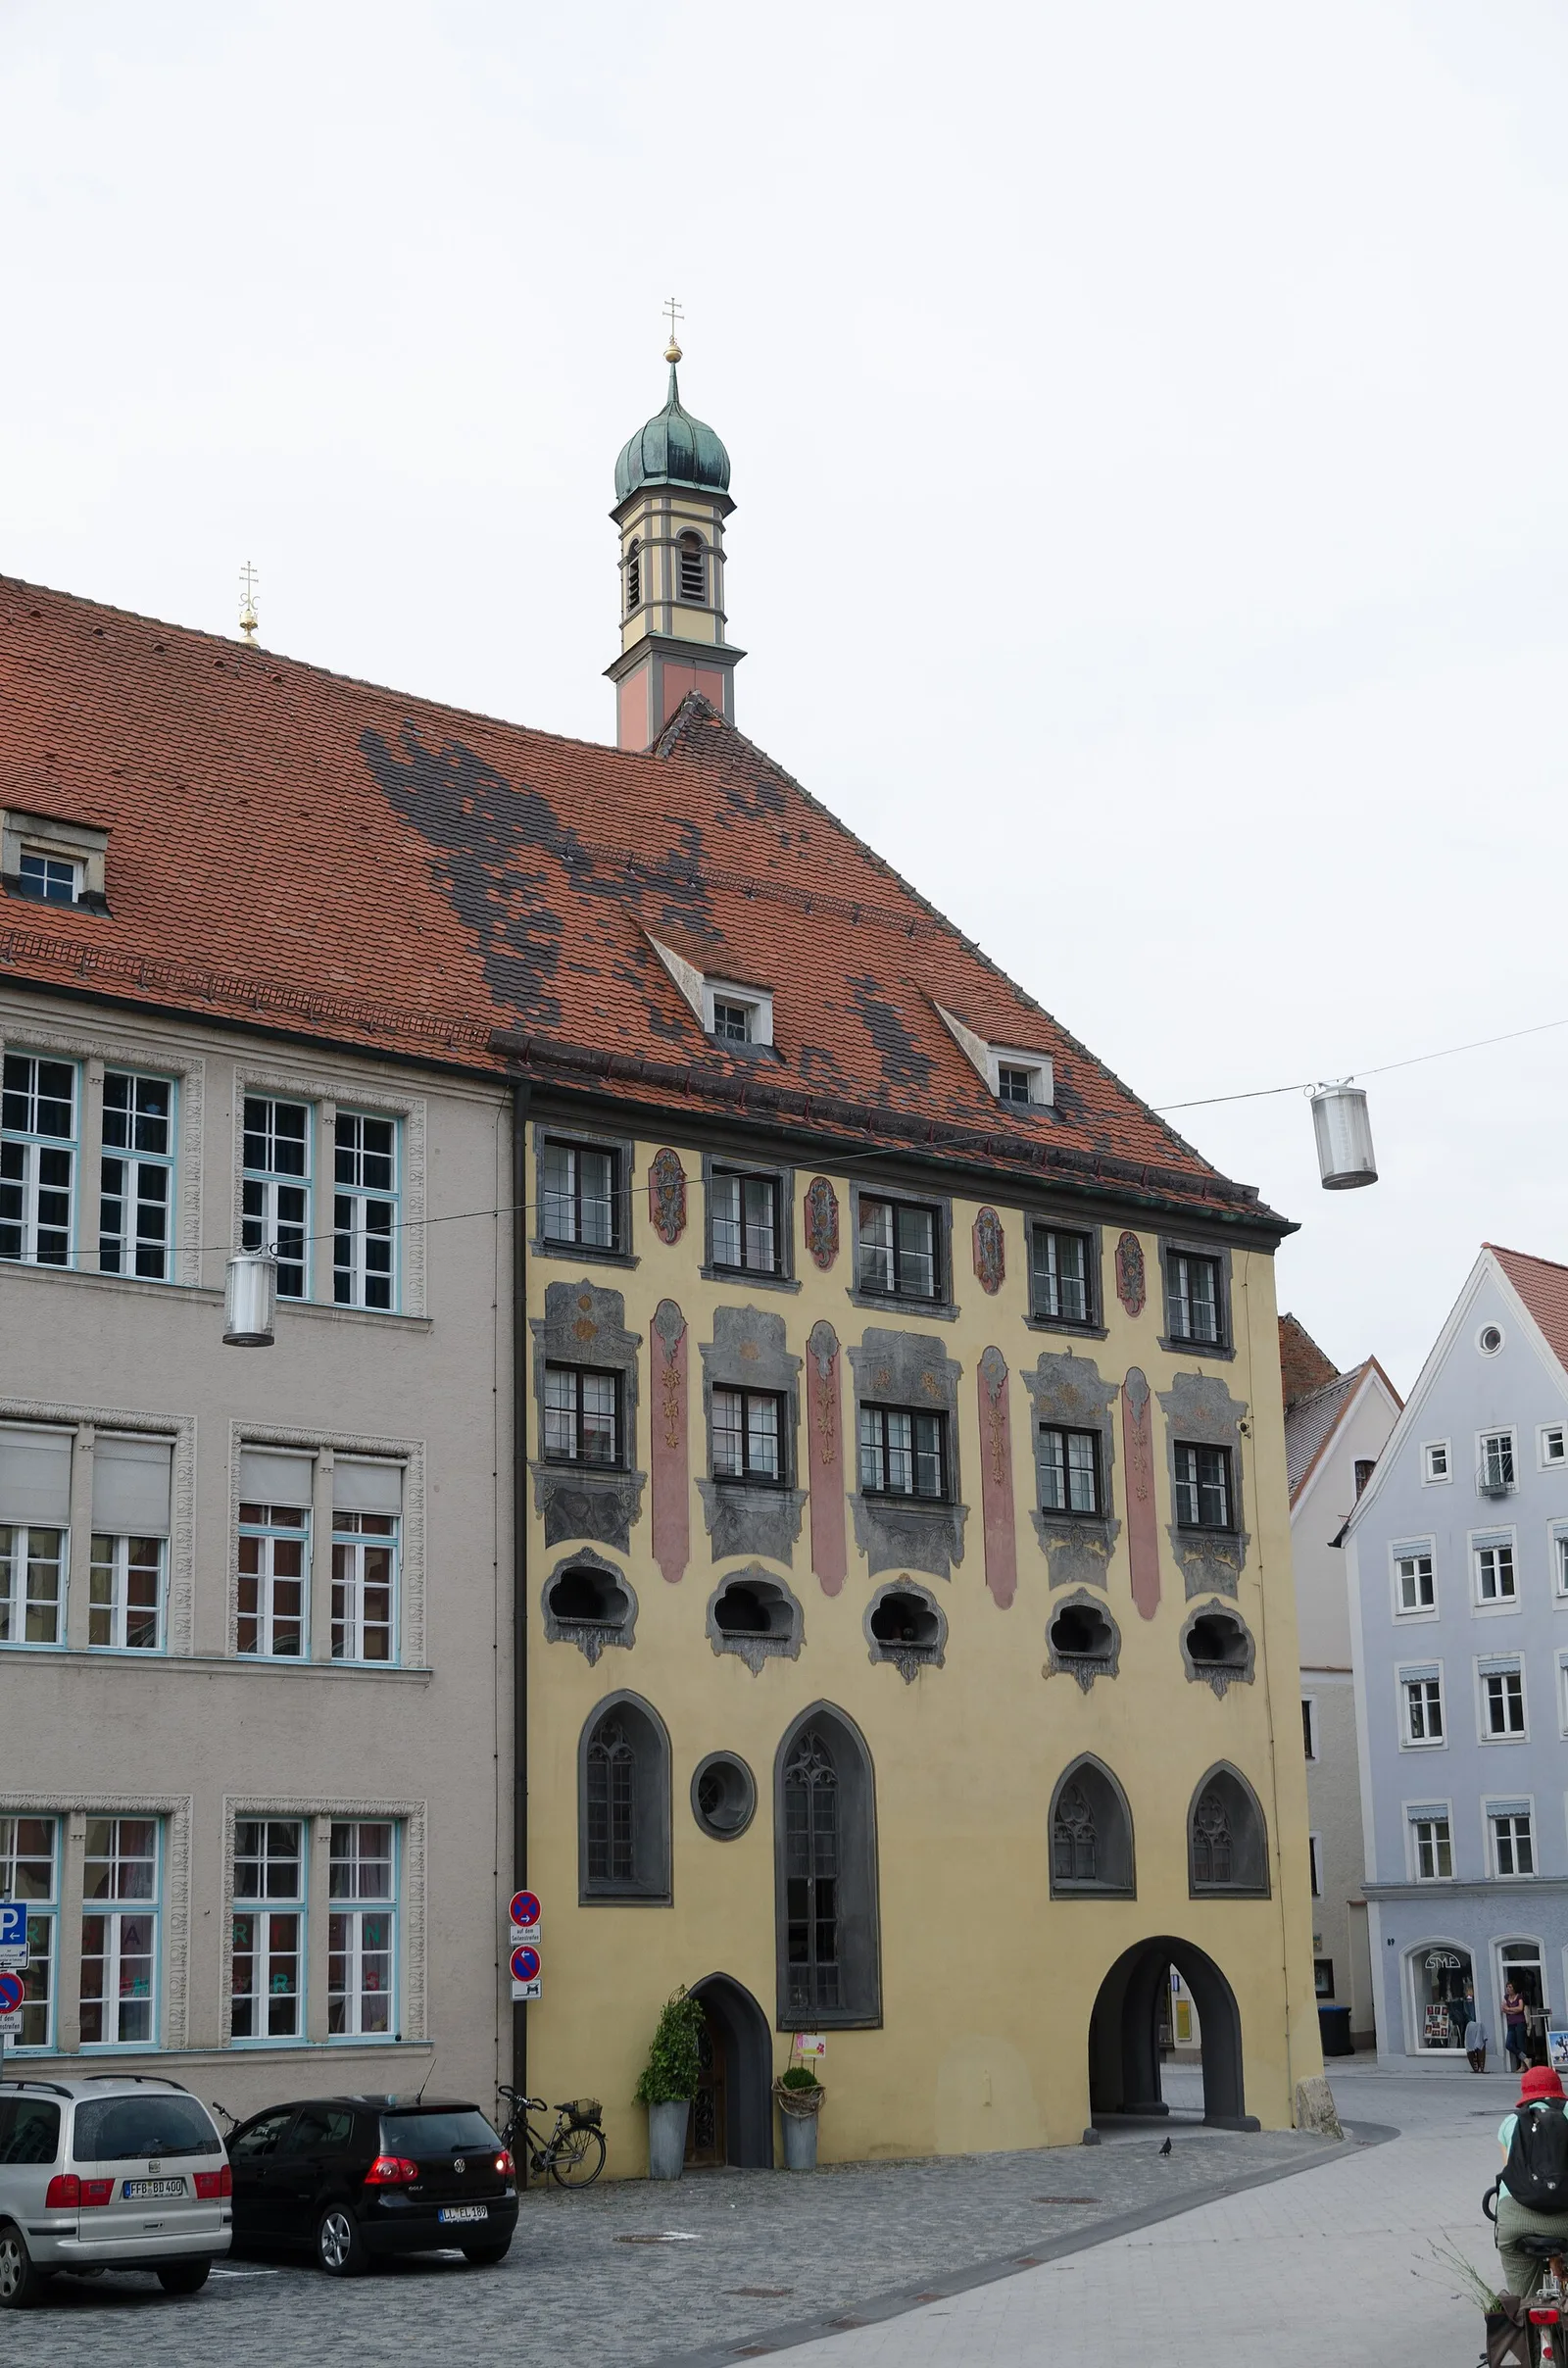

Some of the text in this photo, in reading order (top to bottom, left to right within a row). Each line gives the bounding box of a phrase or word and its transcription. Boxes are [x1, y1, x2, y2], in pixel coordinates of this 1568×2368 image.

[1427, 1956, 1458, 1969] STYLE
[130, 2180, 181, 2195] FFB BD 400
[444, 2206, 487, 2220] LL EL 189
